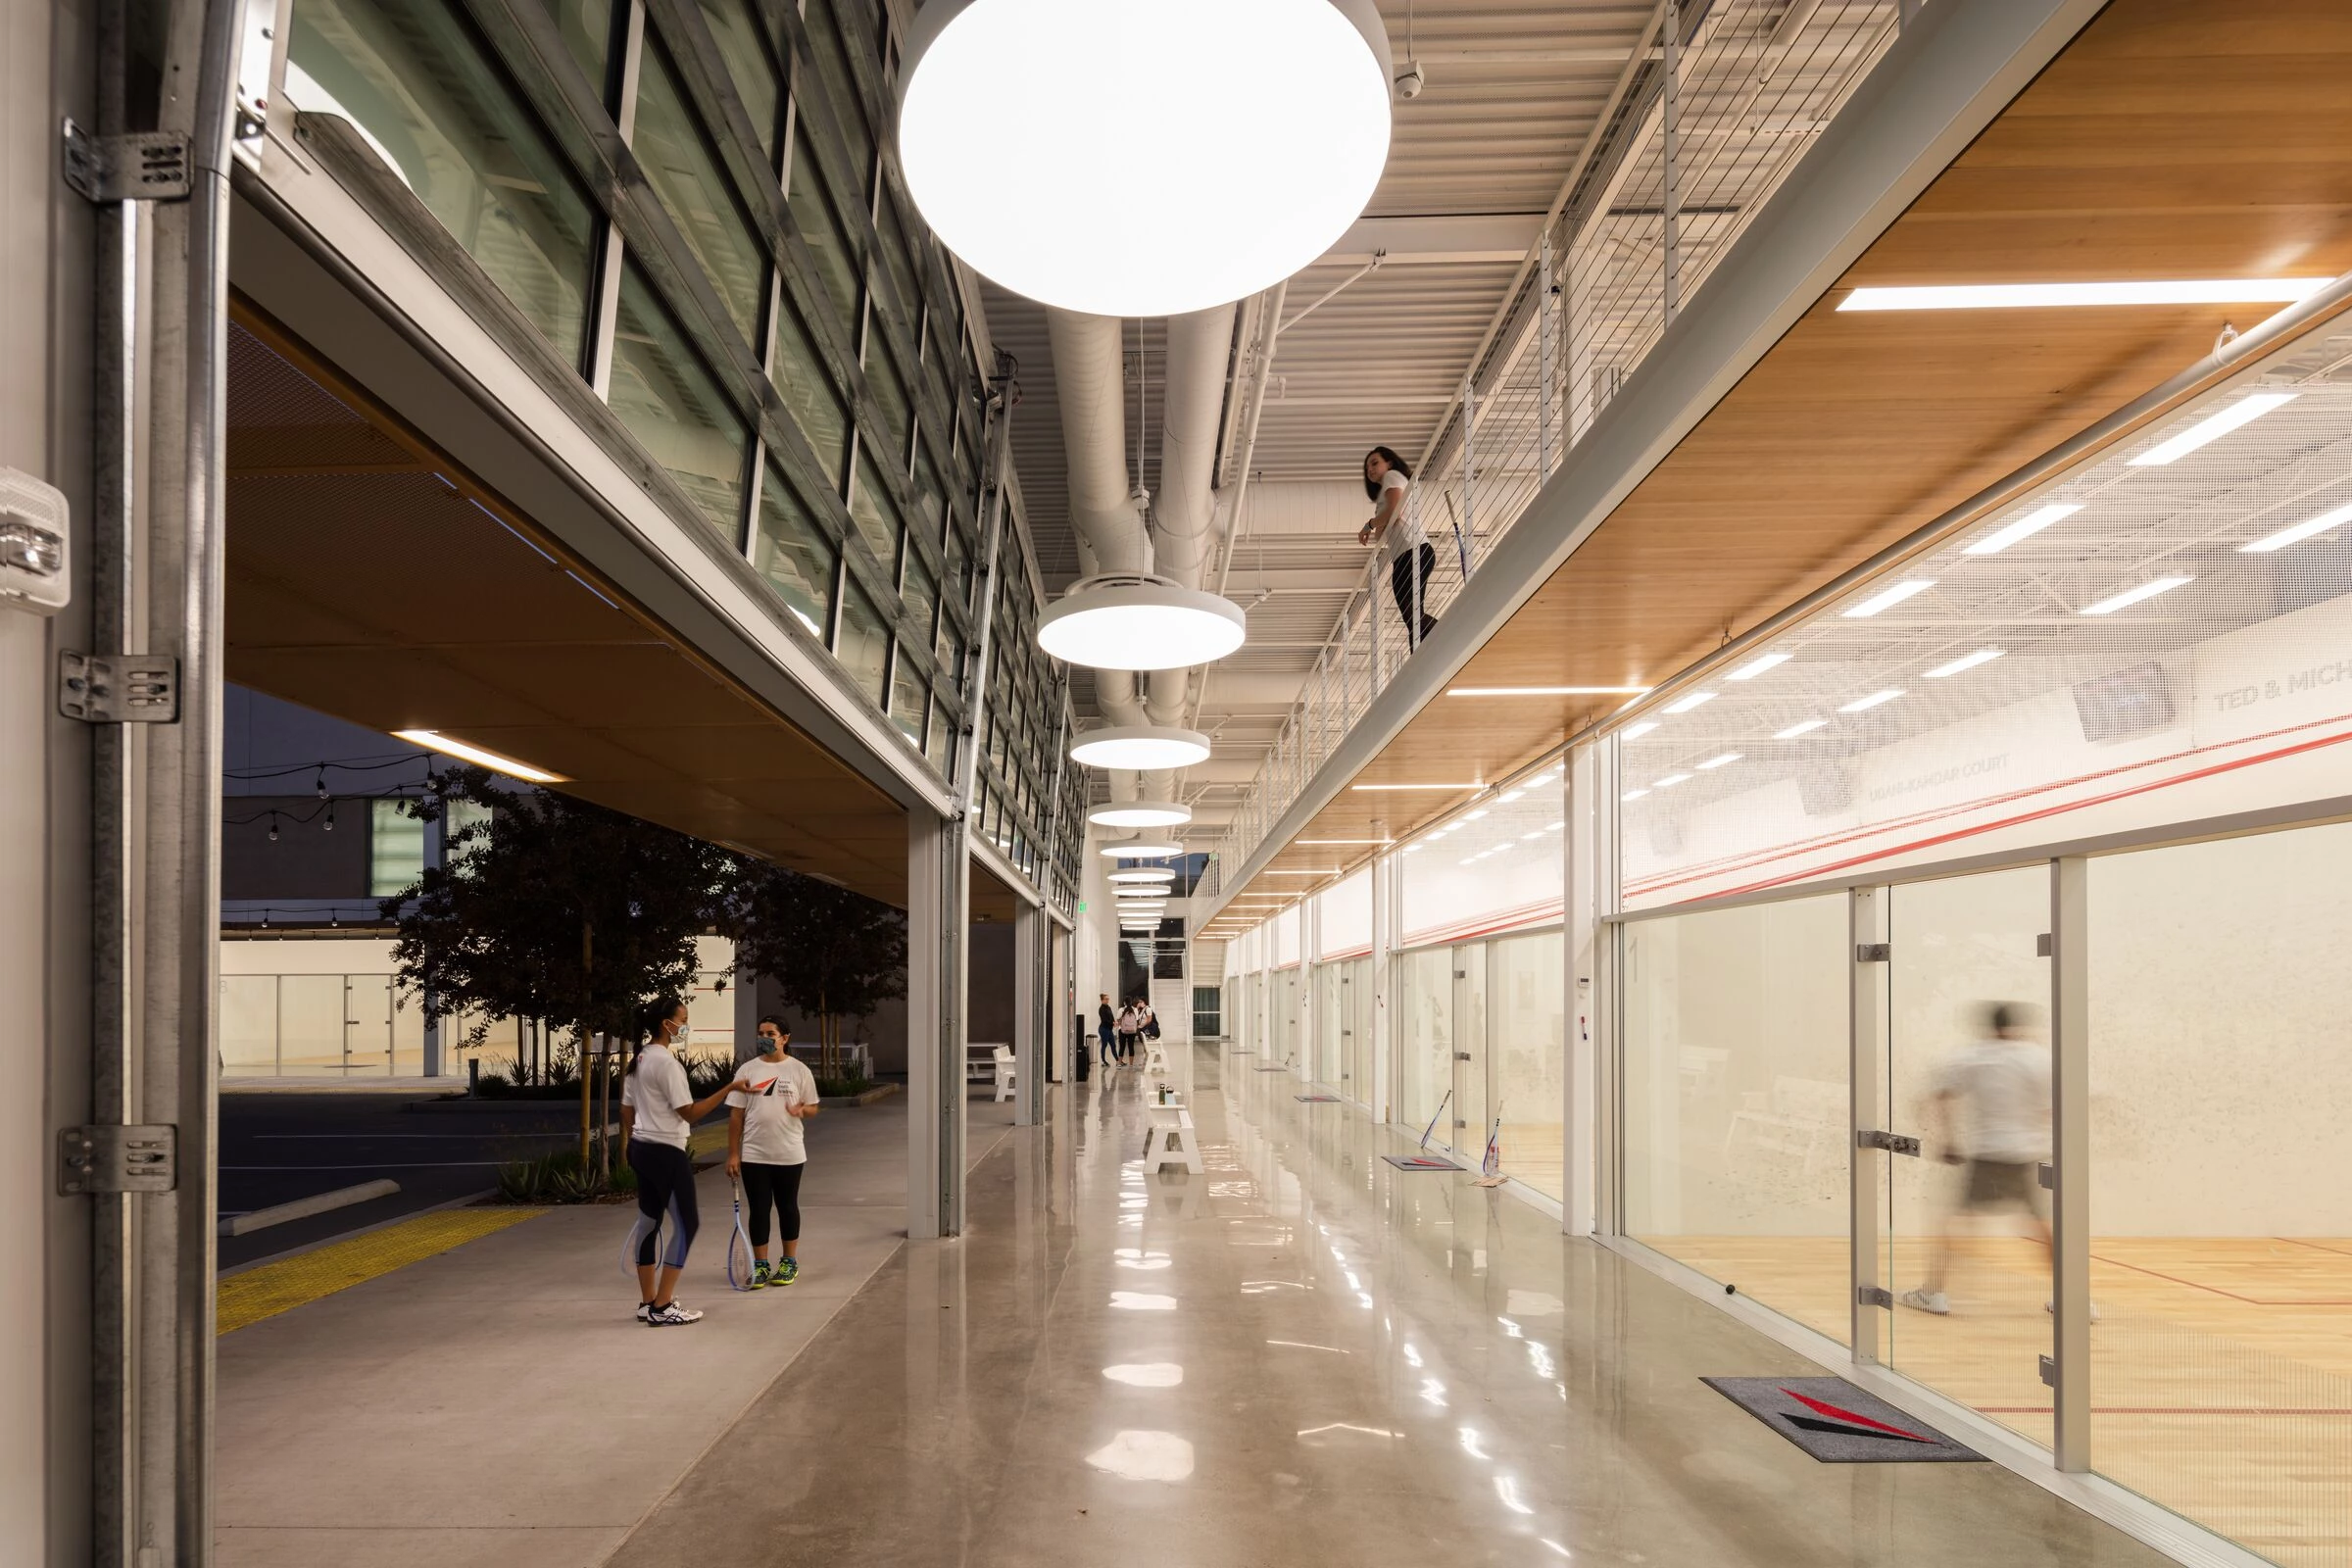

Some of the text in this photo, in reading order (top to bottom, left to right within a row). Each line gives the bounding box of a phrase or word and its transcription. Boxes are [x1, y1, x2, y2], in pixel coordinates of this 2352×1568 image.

[2214, 685, 2258, 711] TED
[2265, 679, 2281, 700] &
[1963, 754, 2009, 778] COURT
